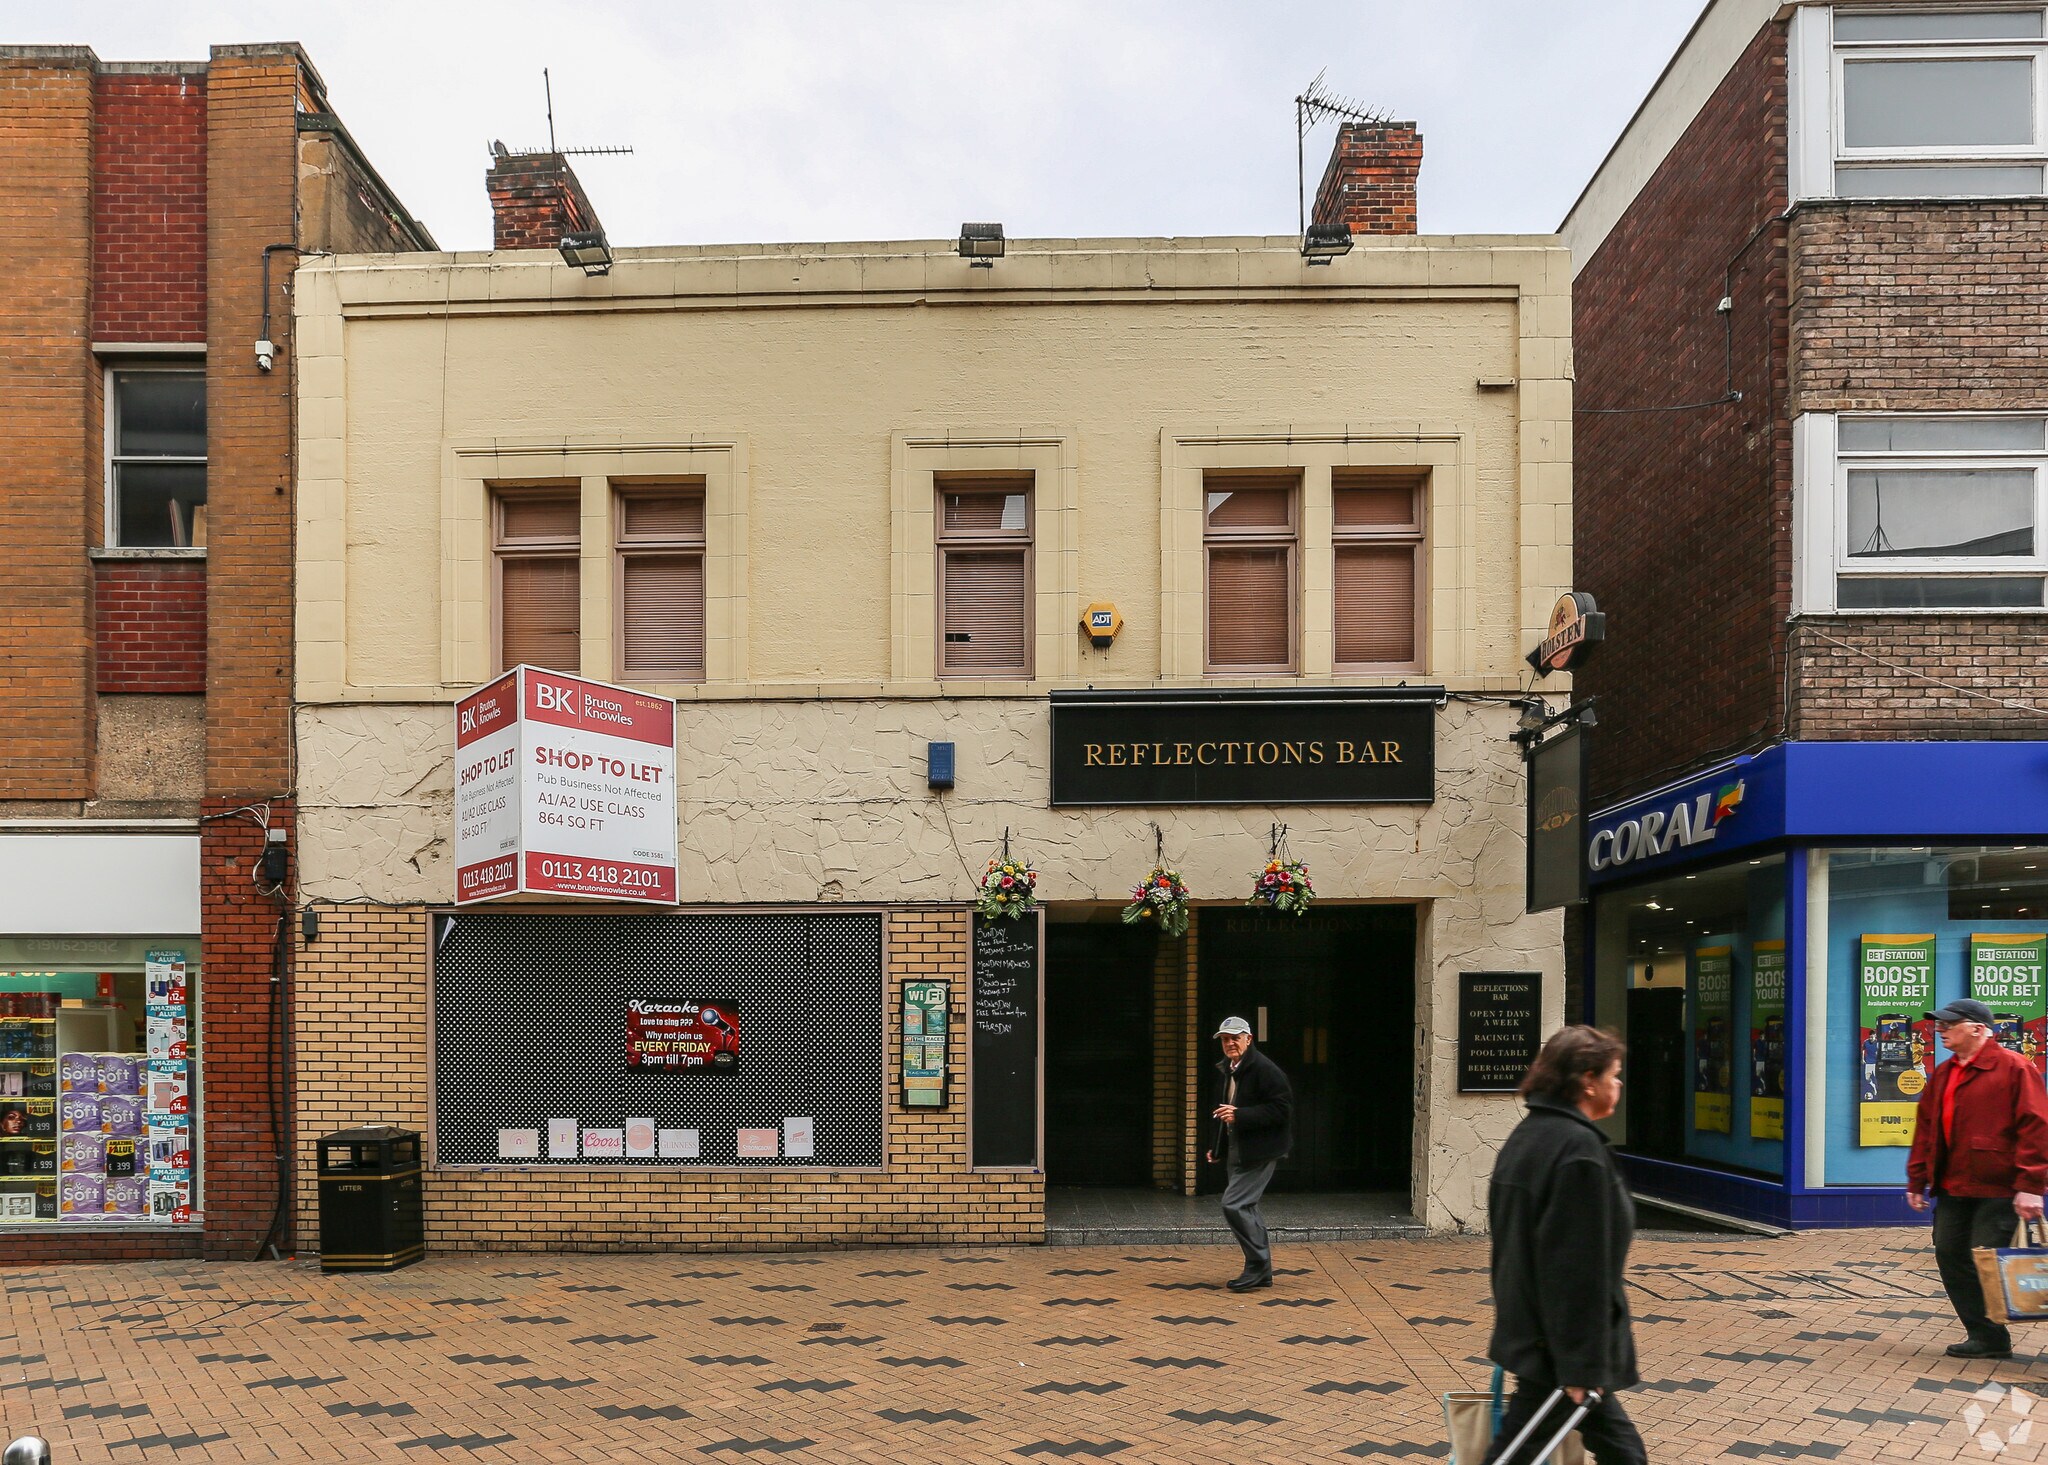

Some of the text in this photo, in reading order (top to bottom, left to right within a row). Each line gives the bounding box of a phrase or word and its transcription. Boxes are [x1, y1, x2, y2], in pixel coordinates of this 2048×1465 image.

[1093, 614, 1111, 624] ADT
[1541, 619, 1582, 662] HOLSTEN
[480, 698, 496, 713] Bruton
[536, 683, 576, 715] BK
[585, 694, 622, 712] Bruton
[635, 700, 663, 711] est.1862
[462, 706, 476, 734] BK
[480, 707, 501, 725] Knowles
[585, 706, 633, 726] Knowles
[1084, 741, 1403, 767] REFLECTIONS BAR
[461, 748, 515, 786] SHOP TO LET
[535, 746, 663, 783] SHOP TO LET
[469, 786, 485, 801] Business
[495, 775, 514, 791] Affected
[537, 773, 662, 801] Pub Business Not Affected
[476, 804, 487, 817] USE
[488, 796, 506, 812] CLASS
[538, 792, 645, 818] A1/A2 USE CLASS
[538, 812, 604, 831] 864 SQ FT
[461, 821, 487, 841] 864 SQ FT
[1588, 792, 1719, 872] CORAL
[633, 850, 649, 858] CODE
[463, 861, 513, 888] 0113 418 2101
[542, 860, 661, 888] 0113 418 2101
[557, 883, 647, 896] www.brutonknowles.co.uk
[977, 927, 1006, 939] SUNDAY
[1003, 960, 1030, 969] MADNESS
[1864, 966, 1930, 984] BOOST
[1974, 965, 2042, 983] BOOST
[1756, 989, 1778, 999] YOUR
[1865, 985, 1929, 997] YOUR BET
[1974, 984, 2041, 996] YOUR BET
[629, 999, 699, 1015] Karaoke
[664, 1018, 679, 1026] sing
[645, 1031, 662, 1040] Why
[677, 1031, 691, 1041] join
[634, 1041, 711, 1052] EVERY FRIDAY
[641, 1054, 663, 1066] 3pm
[666, 1054, 678, 1064] till
[682, 1055, 703, 1066] 7pm
[62, 1067, 96, 1080] Soft
[98, 1069, 129, 1082] Soft
[64, 1105, 98, 1118] Soft
[102, 1110, 135, 1123] Soft
[1881, 1116, 1901, 1124] FUN
[561, 1134, 566, 1142] F
[584, 1132, 620, 1147] Coors
[661, 1141, 697, 1149] GUINNESS
[64, 1147, 99, 1160] Soft
[64, 1188, 99, 1201] Soft
[106, 1189, 140, 1201] Soft
